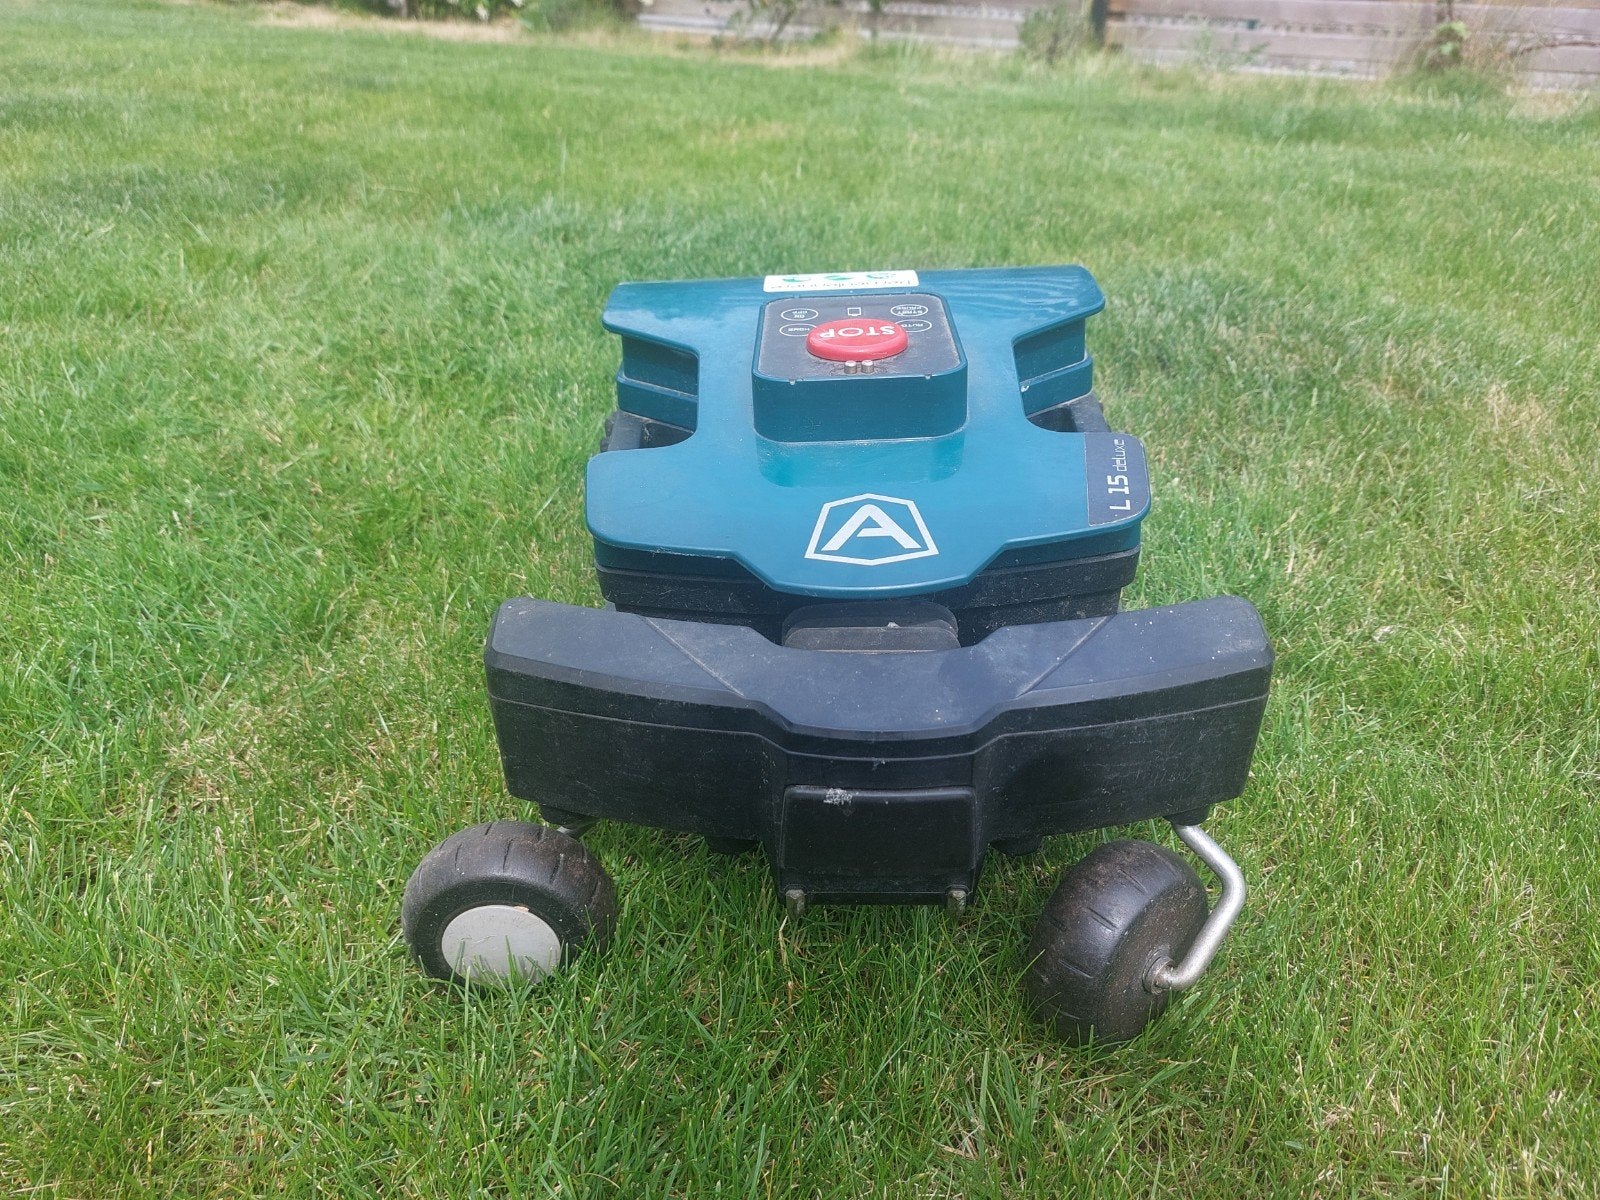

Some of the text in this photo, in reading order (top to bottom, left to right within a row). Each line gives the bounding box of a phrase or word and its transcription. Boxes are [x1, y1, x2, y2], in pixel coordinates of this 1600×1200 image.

[819, 325, 895, 339] STOP
[1106, 438, 1131, 510] L 15 deluxe
[820, 503, 922, 552] A
